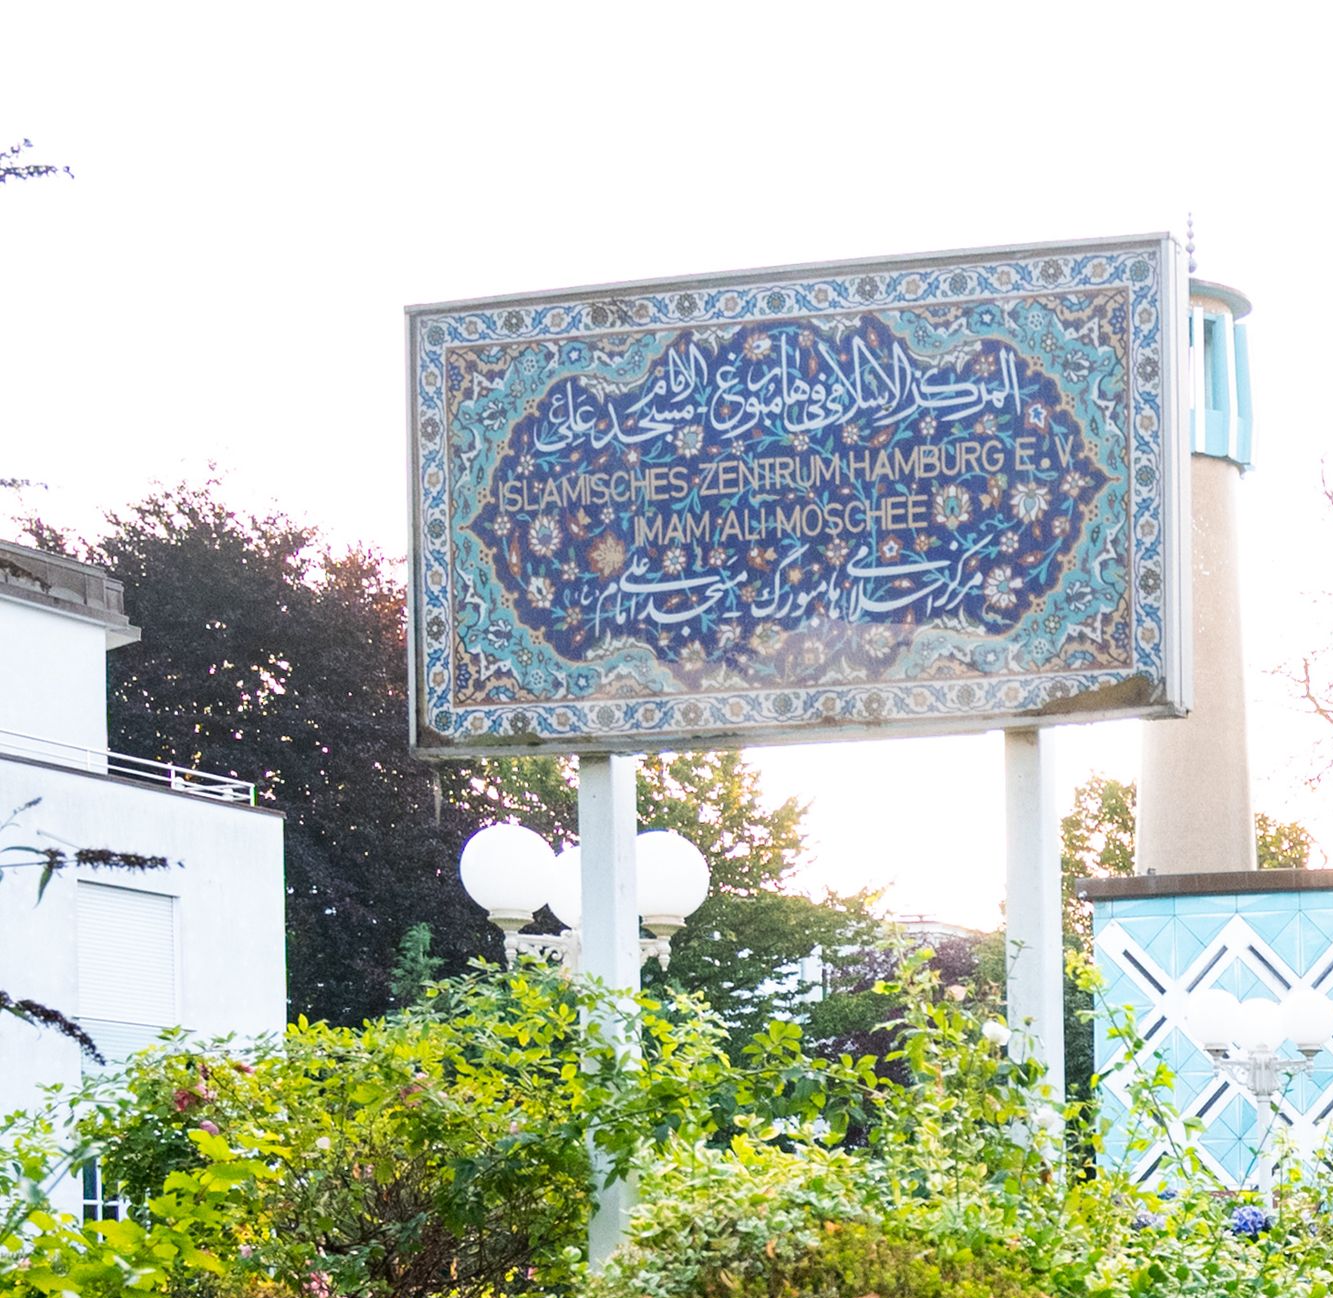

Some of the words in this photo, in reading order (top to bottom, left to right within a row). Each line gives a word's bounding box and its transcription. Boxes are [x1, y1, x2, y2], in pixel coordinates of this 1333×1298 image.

[499, 466, 689, 512] ISLAMISCHES
[699, 451, 841, 497] ZENTRUM
[849, 439, 1005, 482] HAMBURG
[634, 511, 711, 547] IMAM
[720, 508, 767, 541] ALI
[777, 494, 929, 538] MOSCHEE
